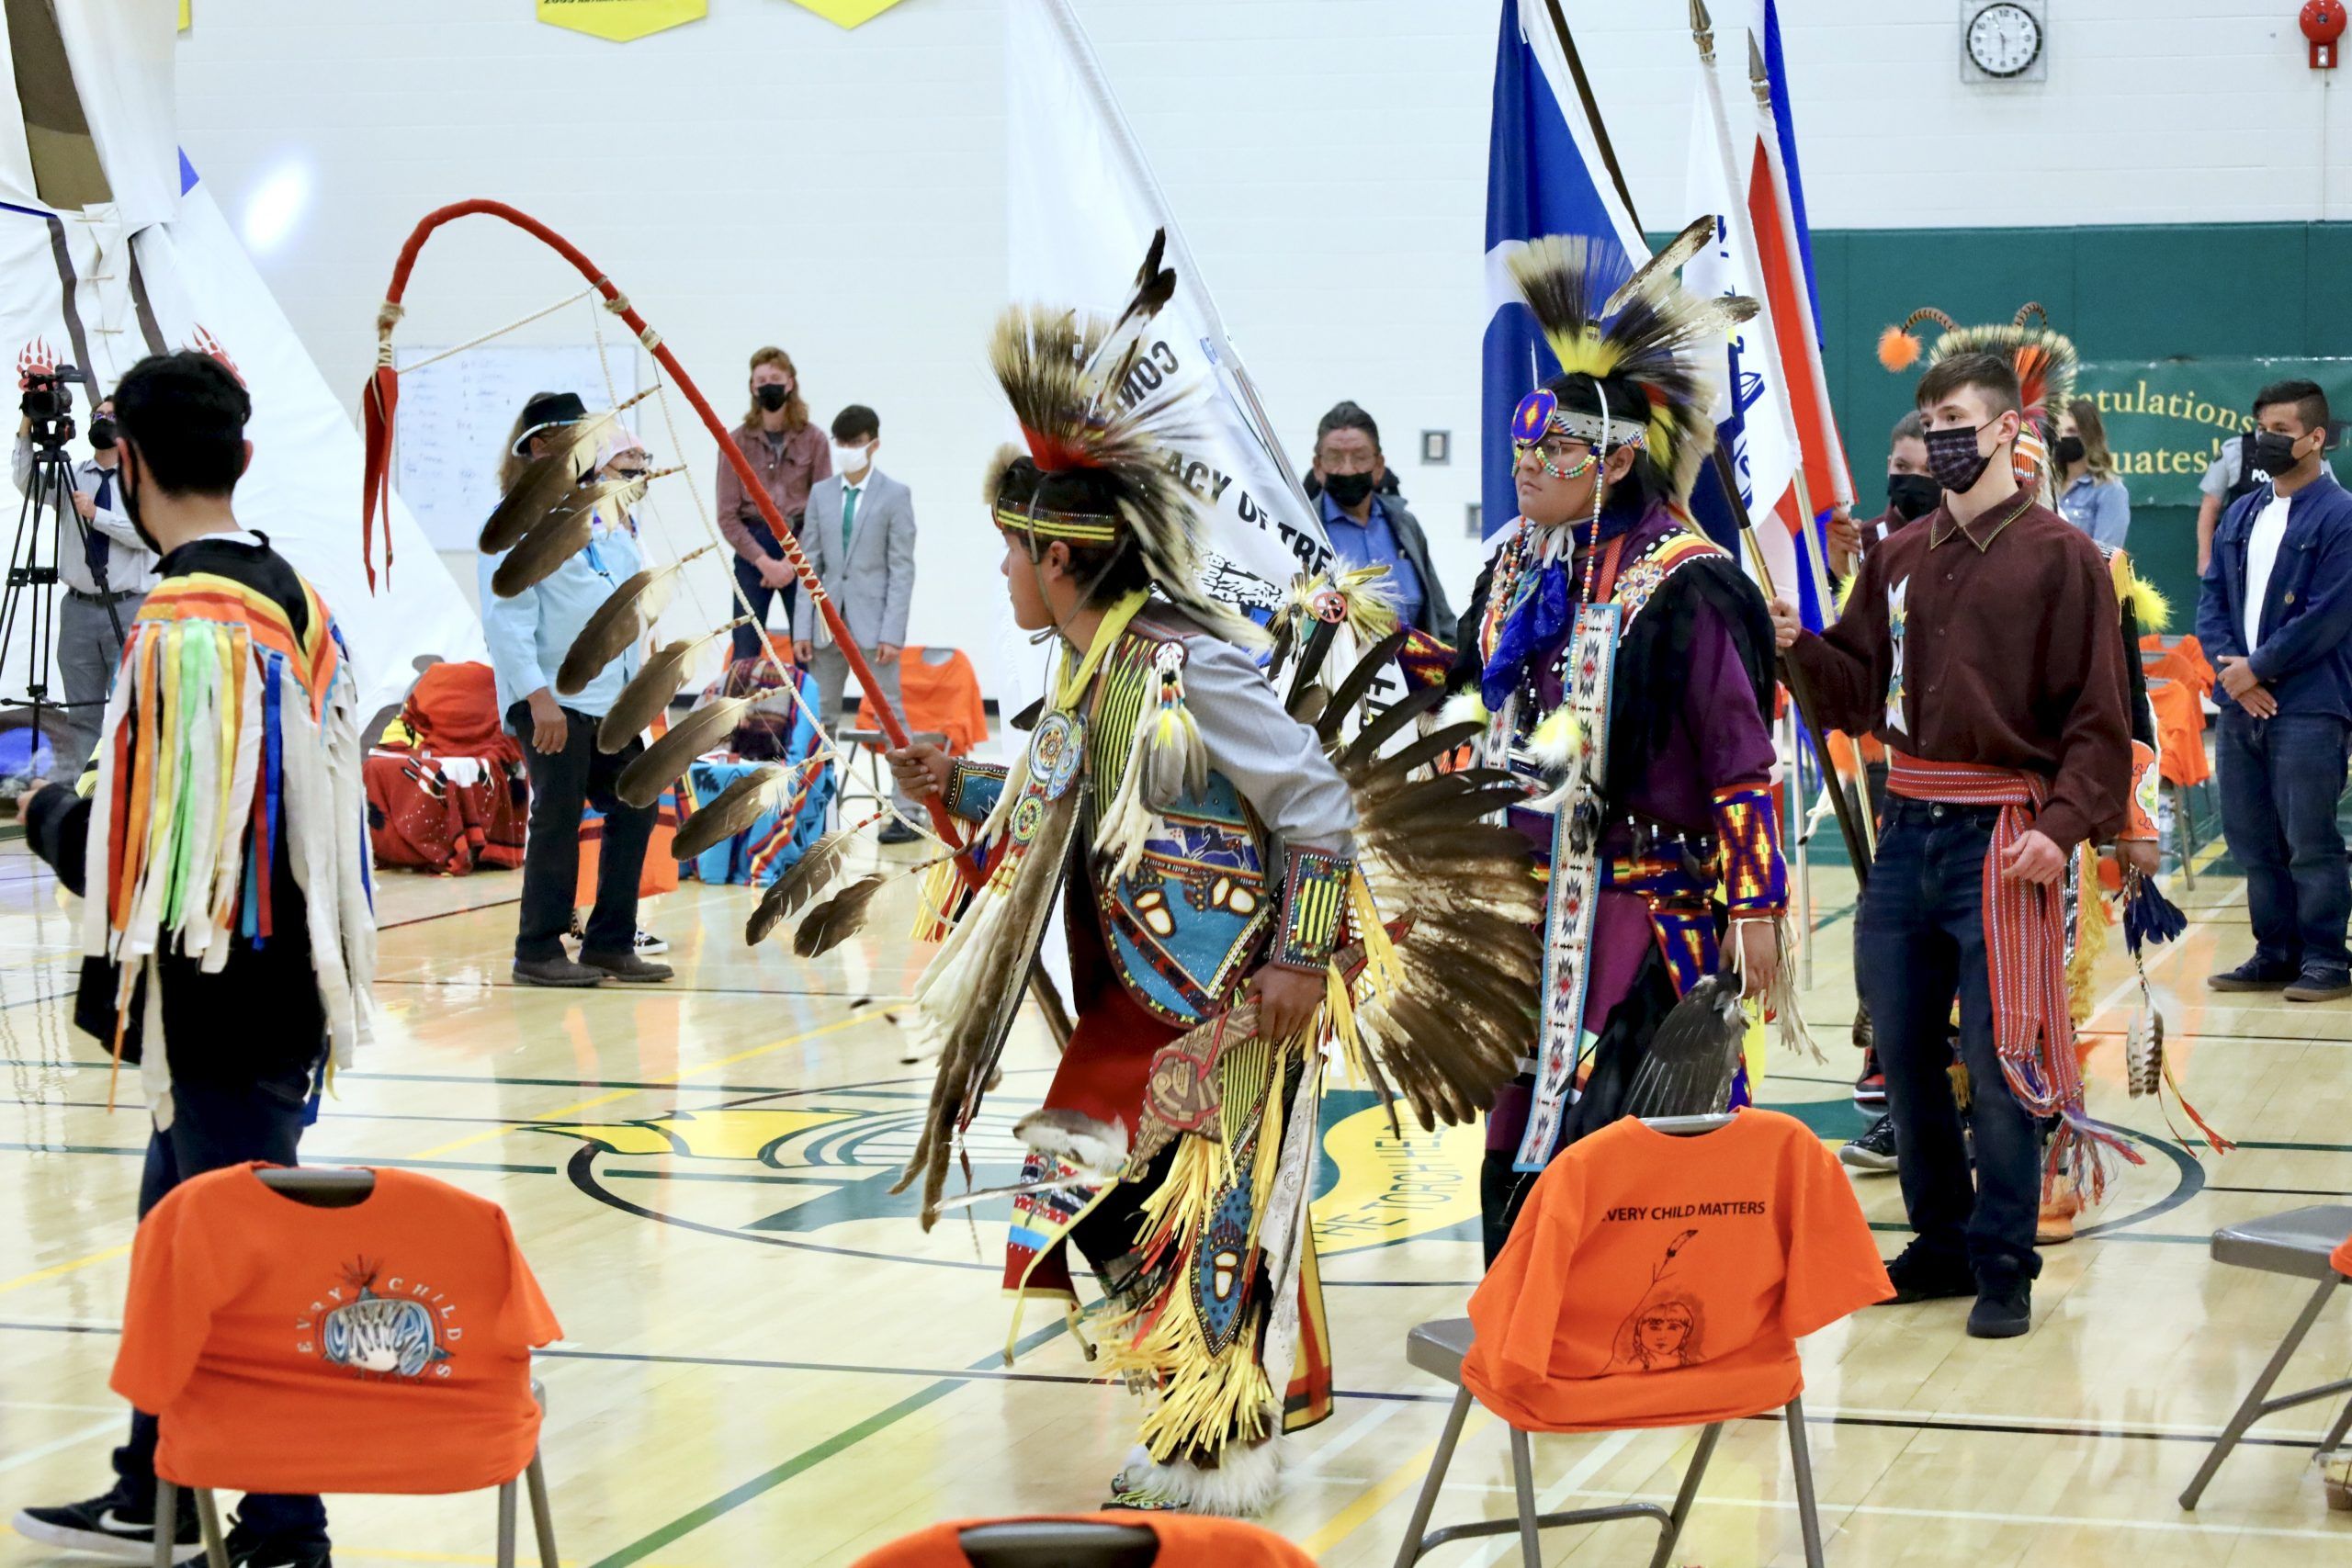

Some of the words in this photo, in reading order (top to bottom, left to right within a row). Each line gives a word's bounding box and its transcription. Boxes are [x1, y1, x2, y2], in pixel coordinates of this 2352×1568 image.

[2067, 379, 2255, 433] tulations
[1164, 449, 1233, 504] ACY
[1238, 490, 1269, 532] OF
[1359, 1163, 1464, 1210] TORCH
[1313, 1213, 1409, 1244] HE
[1601, 1206, 1648, 1223] VERY
[1650, 1203, 1696, 1221] CHILD
[1697, 1201, 1766, 1217] MATTERS
[388, 1277, 463, 1342] CHILD
